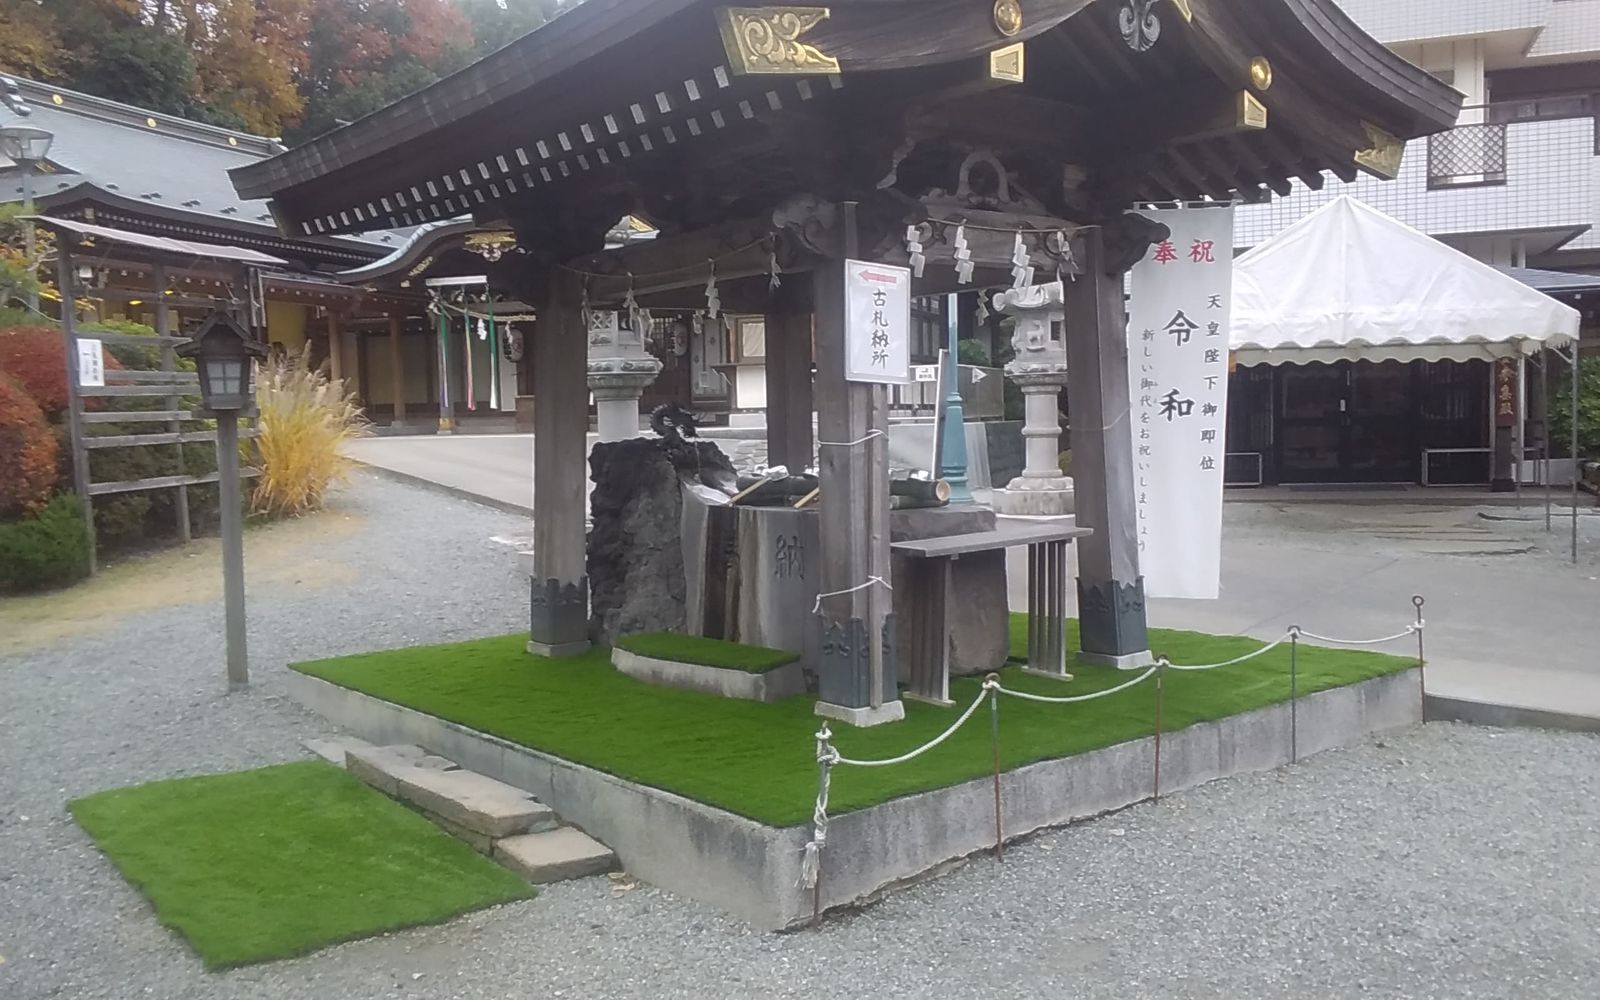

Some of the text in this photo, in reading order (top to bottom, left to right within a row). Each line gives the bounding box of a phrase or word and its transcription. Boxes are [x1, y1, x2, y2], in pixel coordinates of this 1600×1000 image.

[1152, 239, 1215, 265] 奉祝
[871, 288, 889, 369] 古札納所
[1158, 309, 1200, 422] 令和
[1199, 294, 1222, 471] 天皇陛下御即位
[1138, 328, 1155, 552] 新しい御代をお祝いしましょう
